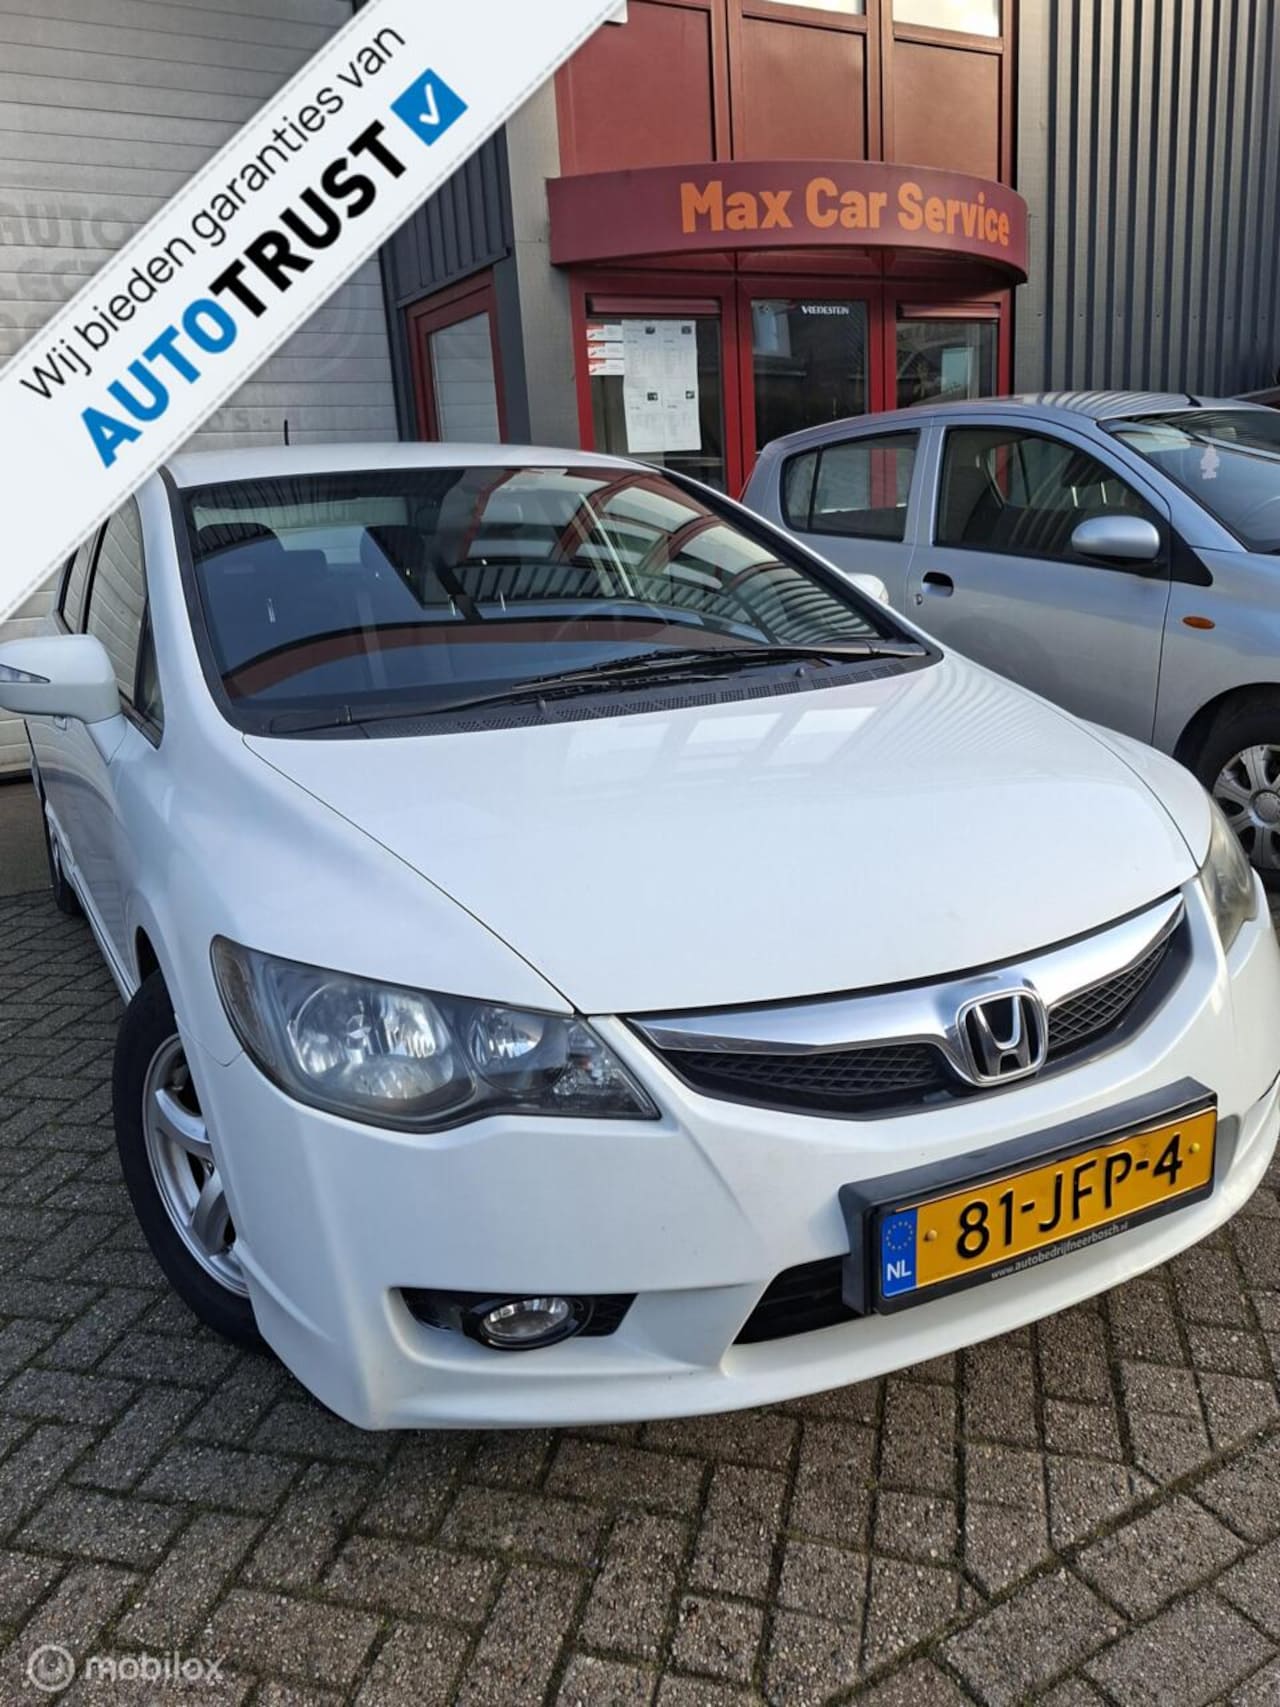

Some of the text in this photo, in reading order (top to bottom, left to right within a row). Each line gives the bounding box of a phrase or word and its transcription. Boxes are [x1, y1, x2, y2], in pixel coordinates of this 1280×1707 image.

[681, 177, 1010, 248] Max Car Service
[957, 1134, 1183, 1260] 81-JFP-4
[886, 1260, 912, 1281] NL
